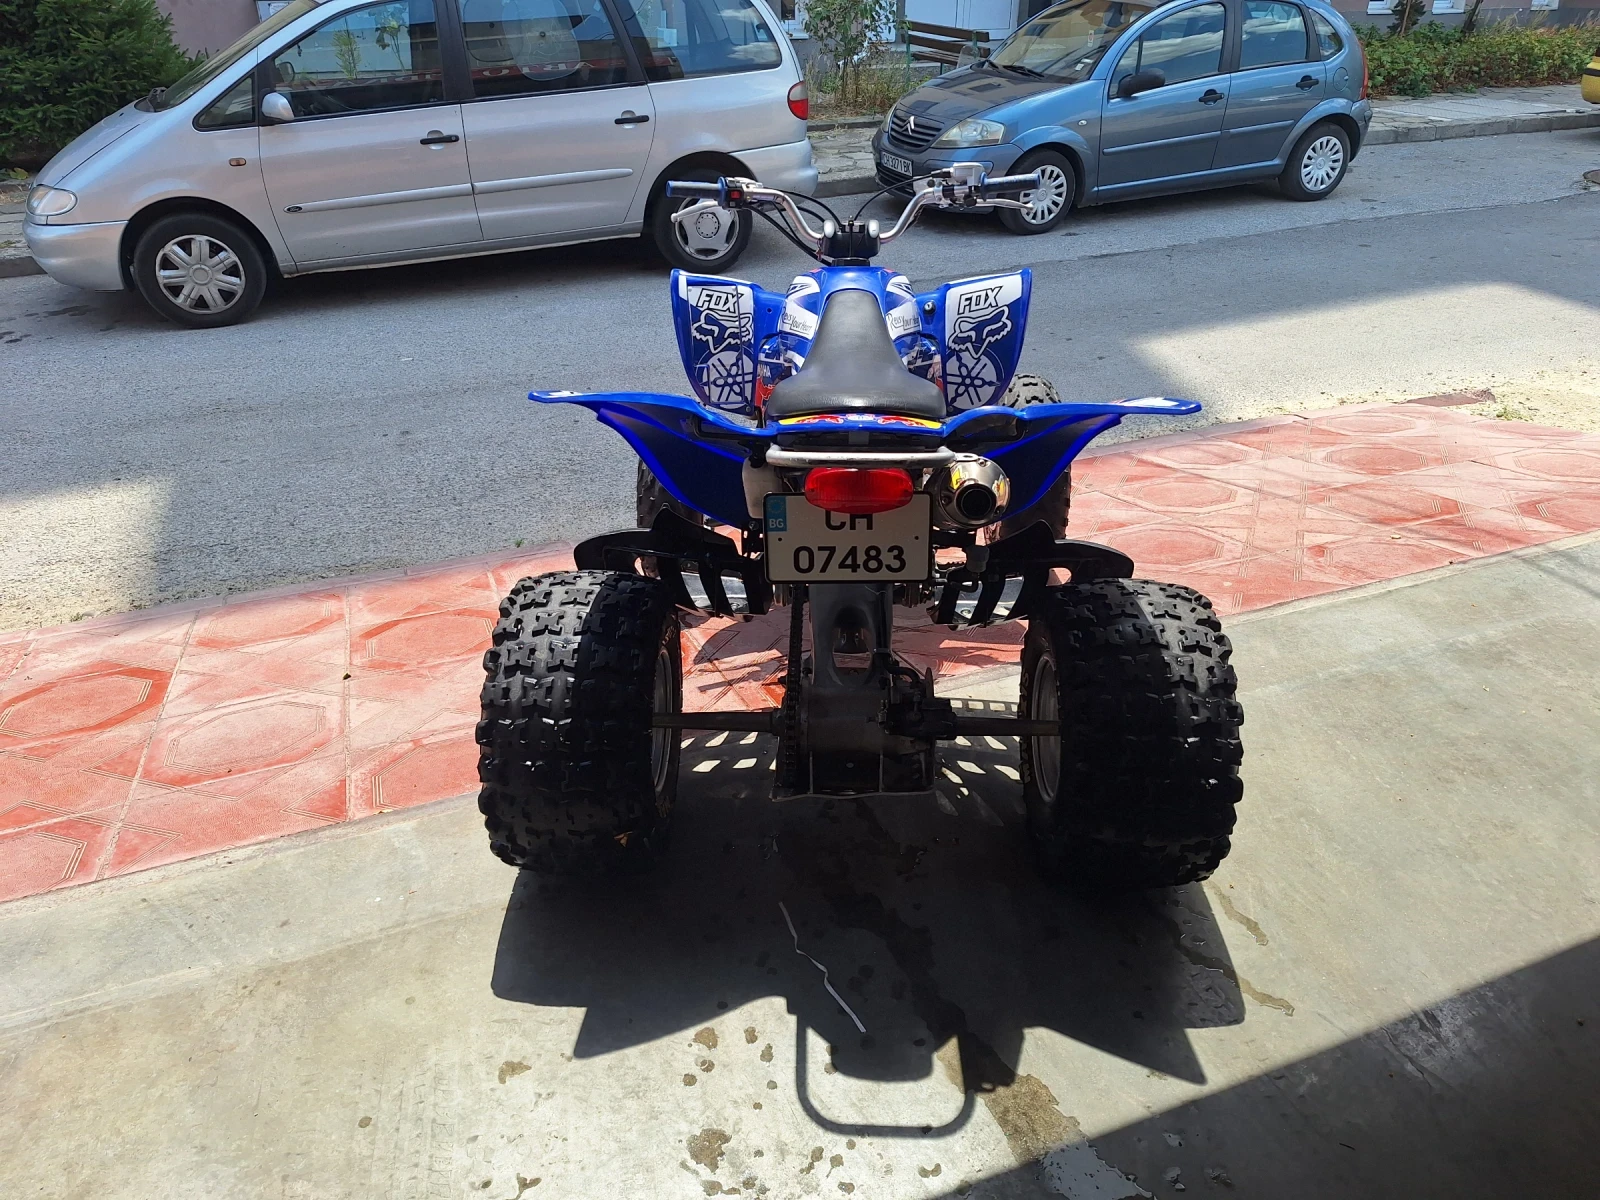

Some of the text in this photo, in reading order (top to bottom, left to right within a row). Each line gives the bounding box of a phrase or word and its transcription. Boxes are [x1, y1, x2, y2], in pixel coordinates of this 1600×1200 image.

[696, 288, 745, 313] FOX
[957, 285, 1003, 315] FOX
[769, 518, 785, 529] BG
[824, 510, 874, 531] CH
[793, 545, 907, 574] 07483
